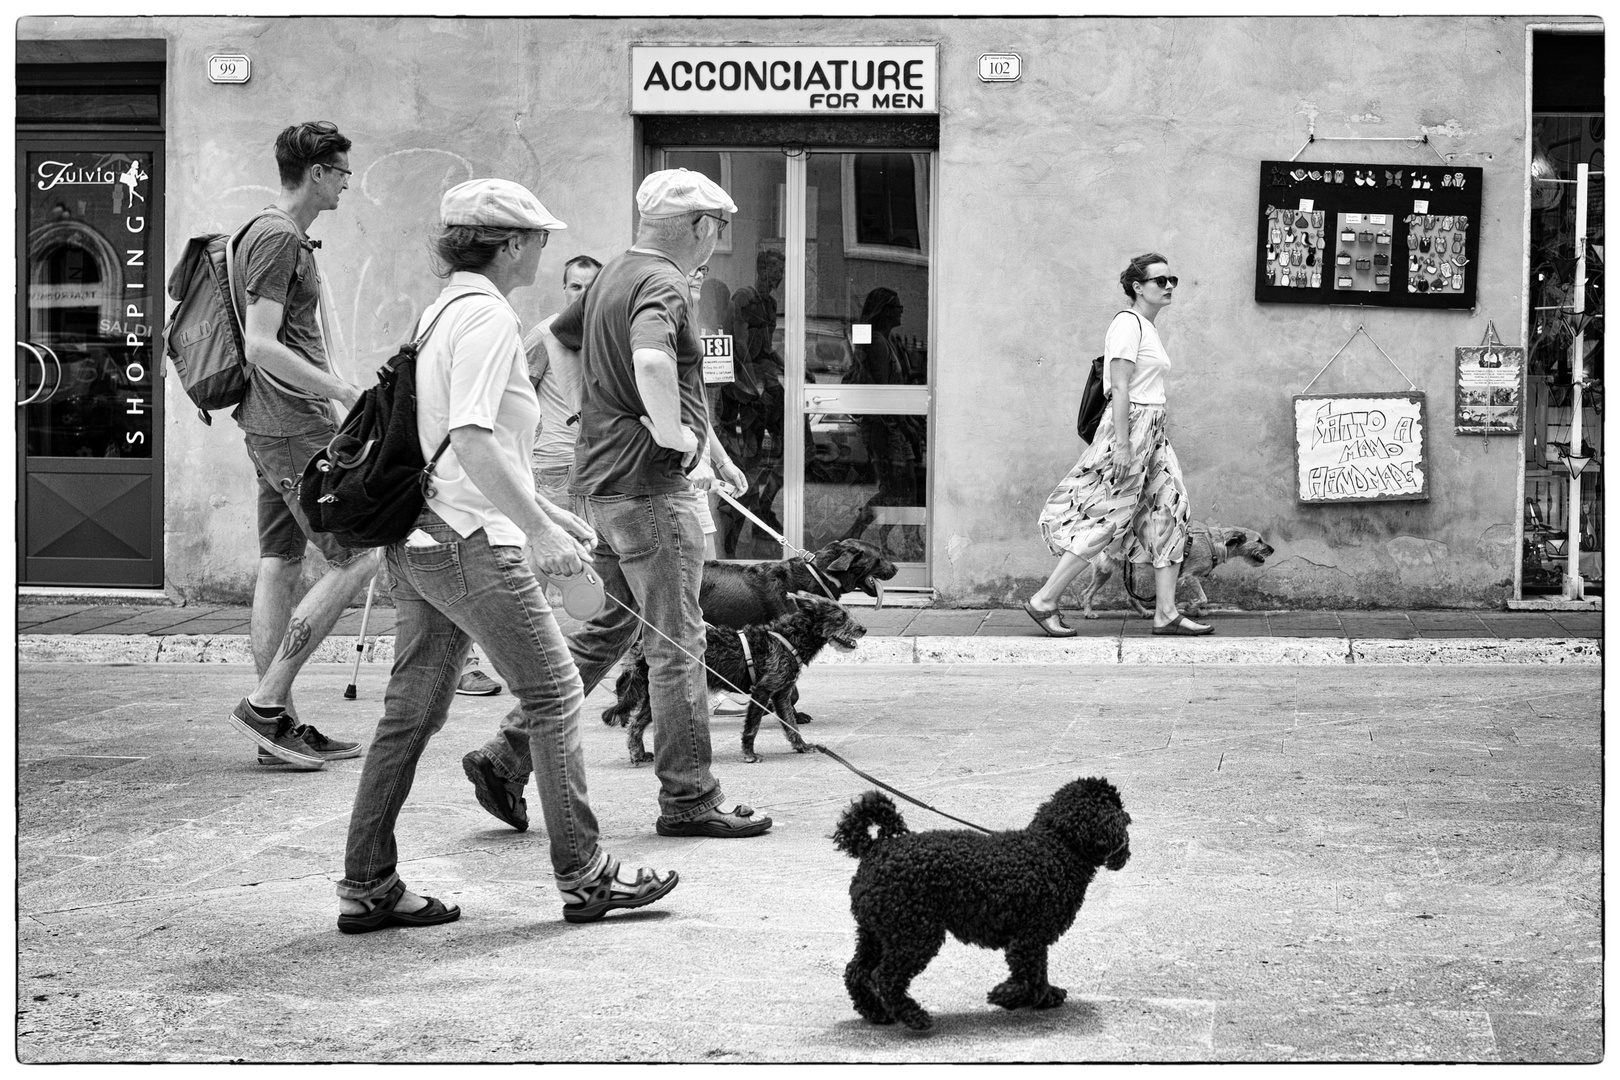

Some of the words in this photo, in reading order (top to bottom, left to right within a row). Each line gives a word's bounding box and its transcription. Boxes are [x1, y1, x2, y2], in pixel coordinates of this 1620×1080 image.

[220, 62, 236, 75] 99
[643, 60, 924, 91] ACCONCIATURE
[990, 61, 1010, 75] 102
[810, 93, 860, 109] FOR
[872, 93, 924, 109] MEN
[37, 160, 115, 191] Fulvia
[99, 318, 153, 338] SALDI
[126, 216, 145, 444] SHOPPING
[1311, 401, 1387, 450] FATTO
[1393, 416, 1415, 443] A
[1338, 436, 1404, 464] MANO
[1308, 460, 1417, 498] HANDMADE
